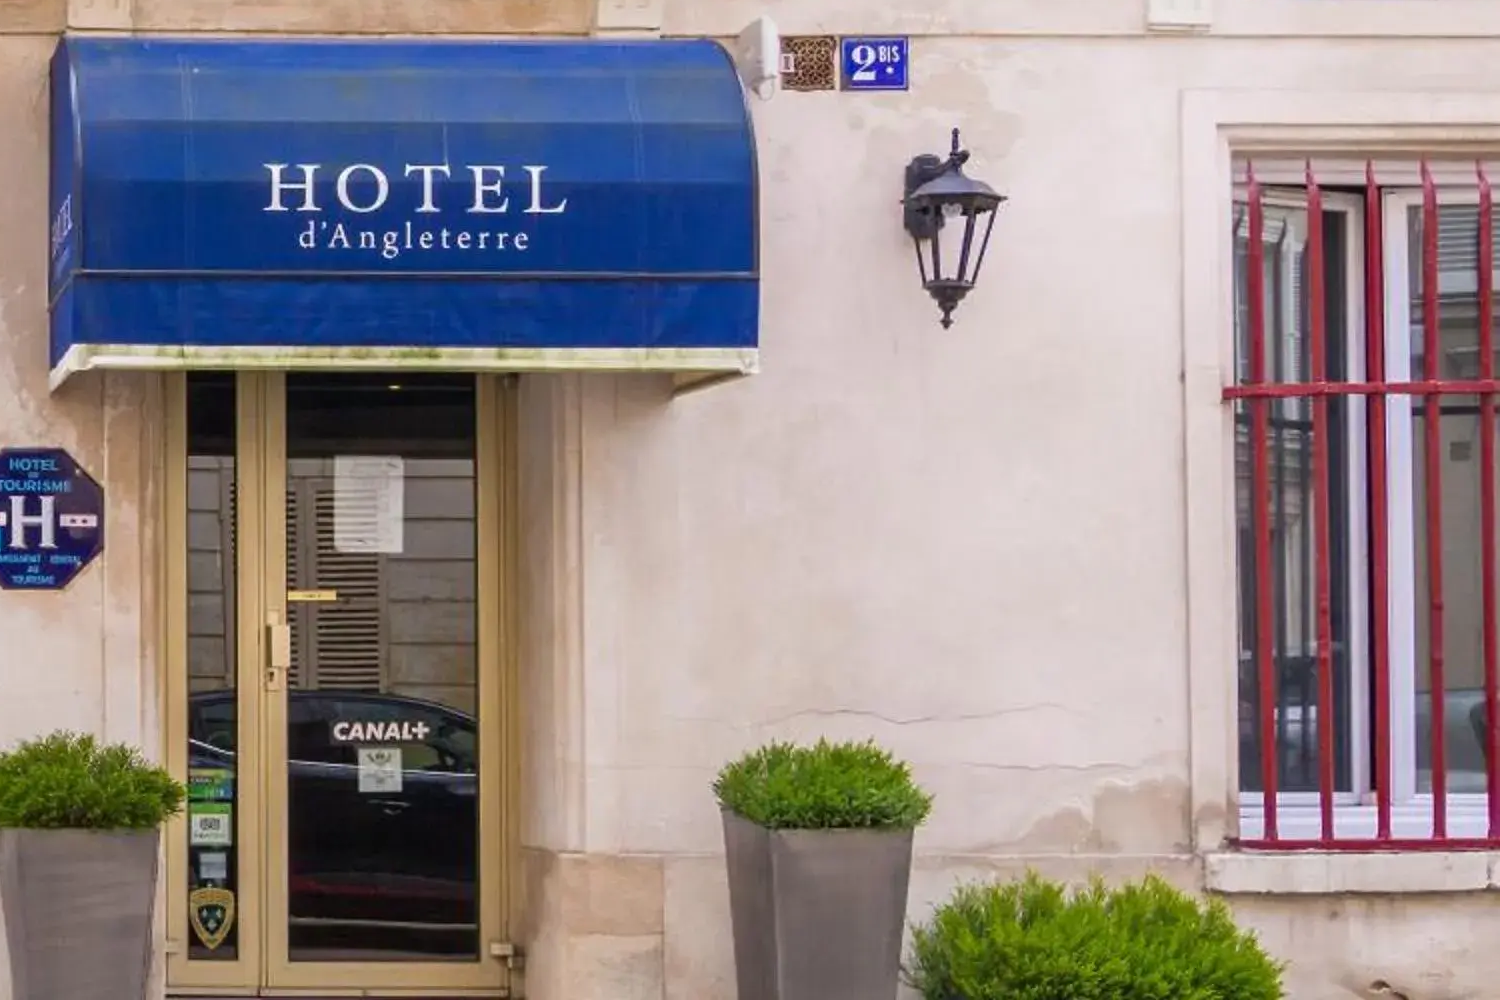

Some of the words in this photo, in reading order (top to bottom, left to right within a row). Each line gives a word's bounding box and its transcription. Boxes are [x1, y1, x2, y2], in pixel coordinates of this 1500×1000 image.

[851, 45, 877, 81] 2
[879, 45, 900, 63] BIS
[262, 163, 567, 214] HOTEL
[299, 222, 530, 258] d'Angleterre
[9, 457, 60, 471] HOTEL
[8, 495, 59, 549] H
[333, 721, 430, 741] CANAL+
